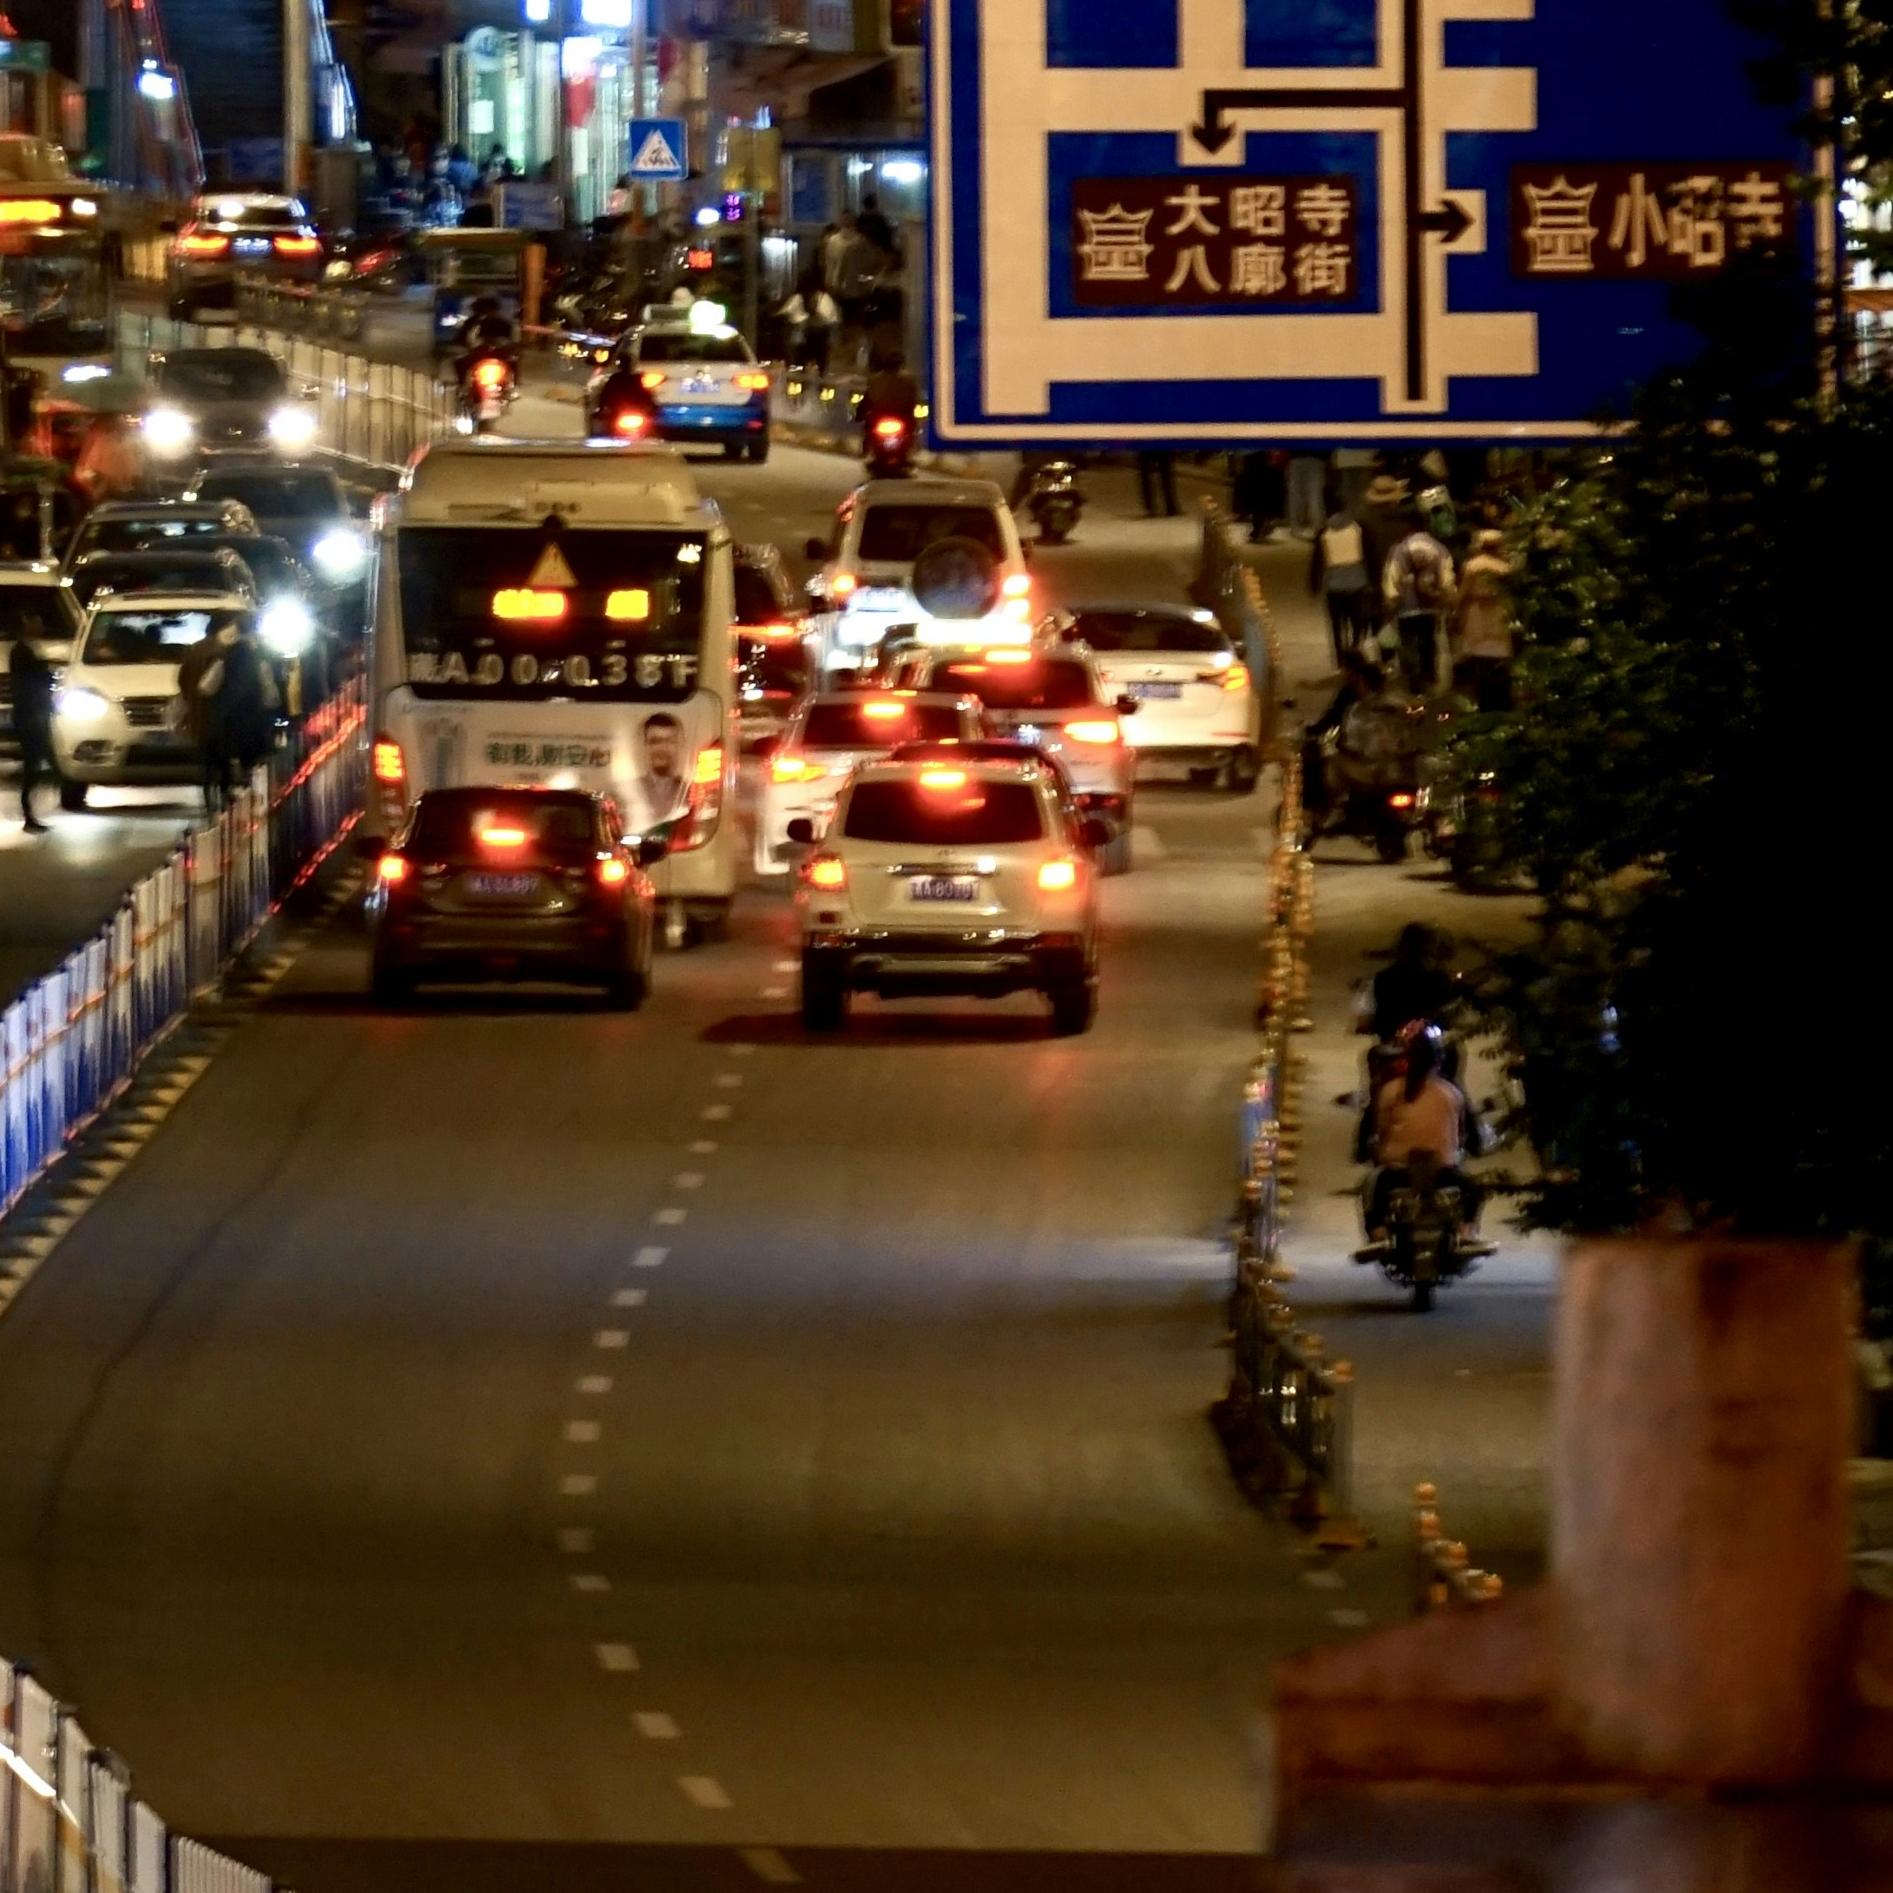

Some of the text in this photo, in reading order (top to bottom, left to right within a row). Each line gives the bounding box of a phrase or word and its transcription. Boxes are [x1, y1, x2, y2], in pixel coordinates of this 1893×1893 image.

[1163, 183, 1351, 237] 大昭寺
[1608, 170, 1784, 268] 小昭寺
[1163, 242, 1351, 296] 八廓街
